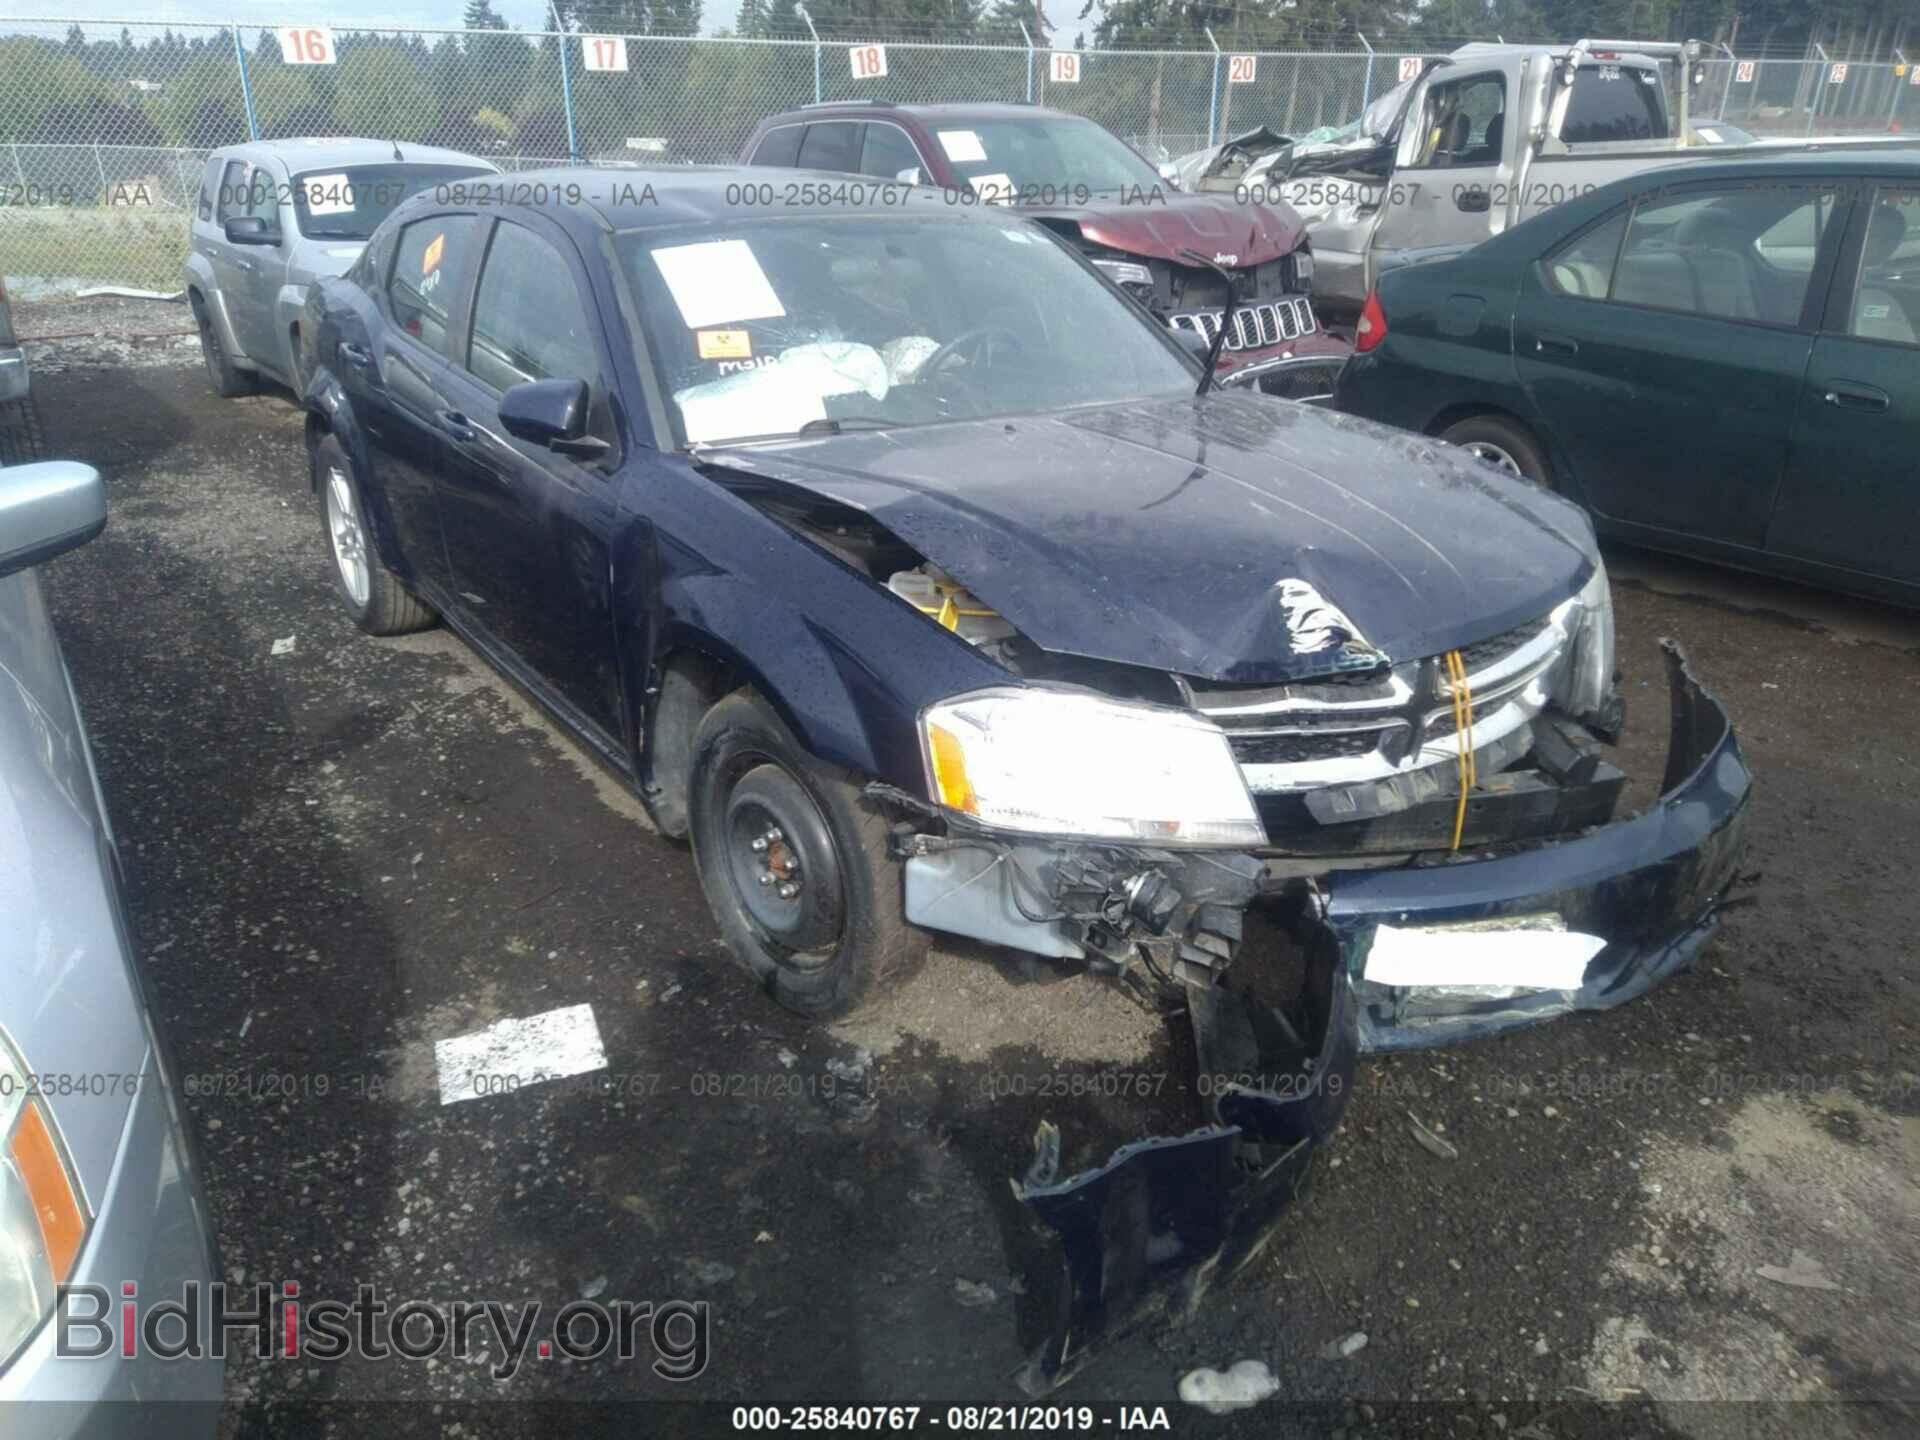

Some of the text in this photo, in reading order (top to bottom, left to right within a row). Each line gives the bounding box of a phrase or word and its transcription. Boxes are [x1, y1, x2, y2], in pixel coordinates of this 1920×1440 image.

[288, 29, 327, 62] 16
[593, 39, 617, 68] 17
[856, 47, 881, 76] 18
[1055, 55, 1075, 80] 19
[1231, 57, 1254, 81] 20
[1402, 59, 1419, 81] 21
